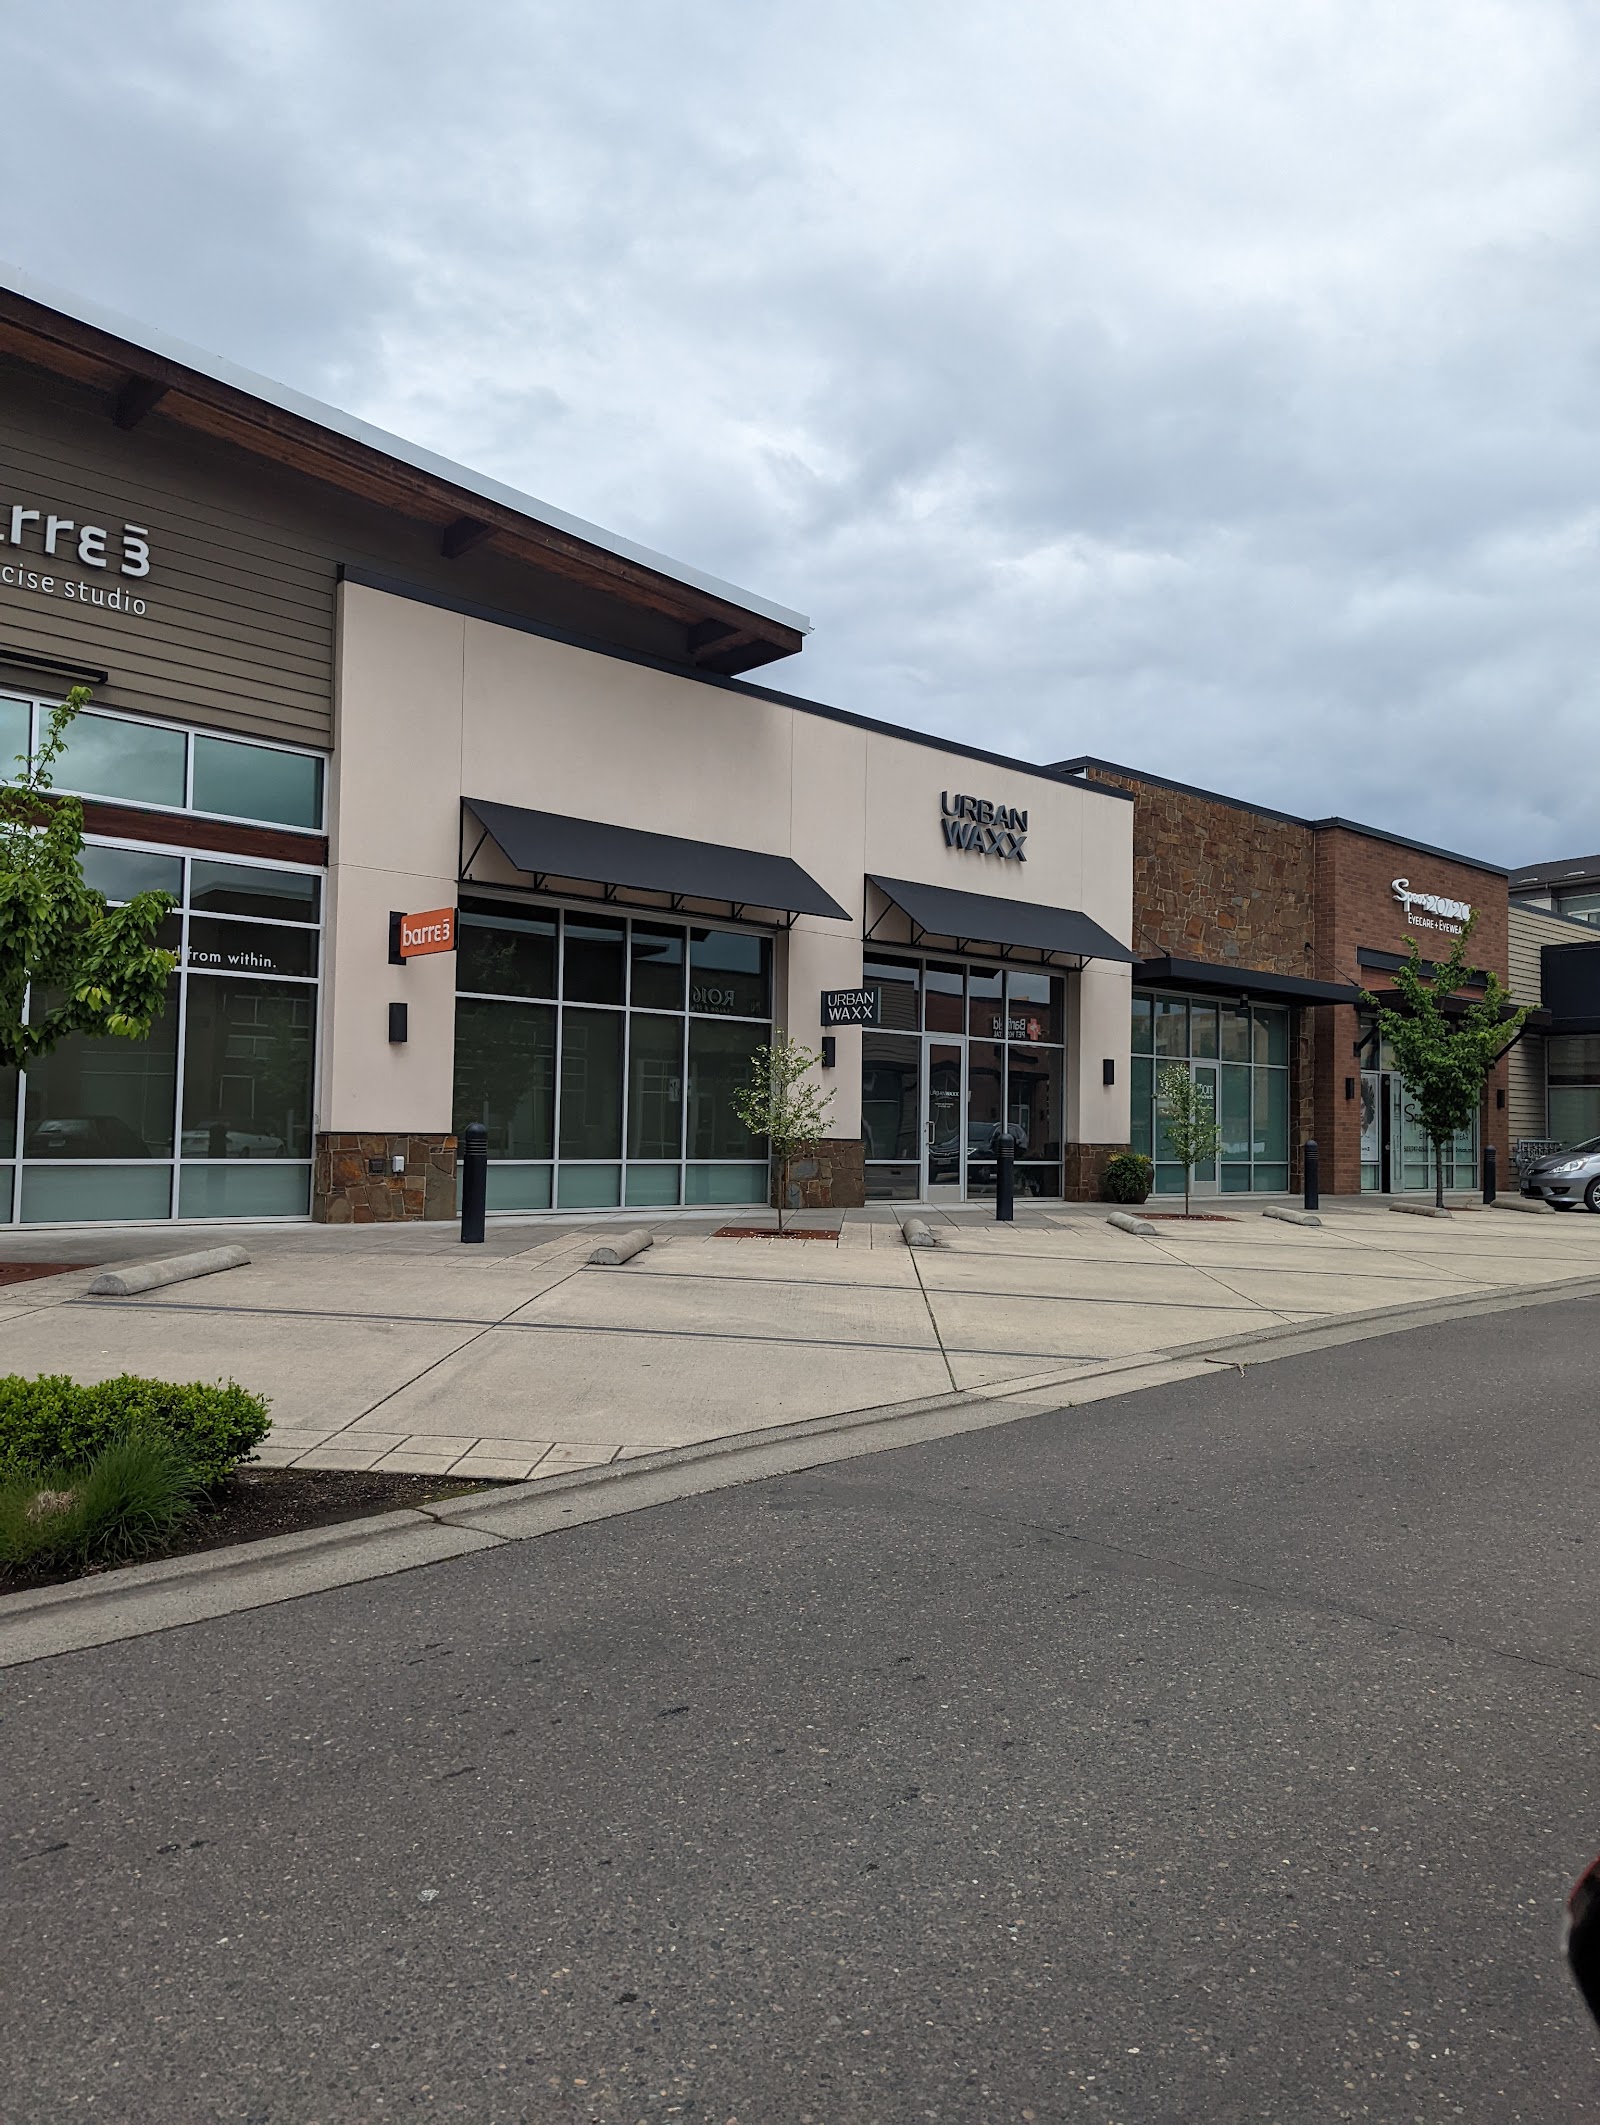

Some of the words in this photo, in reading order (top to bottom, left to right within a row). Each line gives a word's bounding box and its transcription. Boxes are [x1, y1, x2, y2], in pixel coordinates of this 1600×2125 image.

[0, 505, 150, 577] rre3
[64, 581, 146, 615] studio
[941, 791, 1028, 832] URBAN
[941, 818, 1028, 862] WAXX
[1439, 920, 1464, 935] EYEWEA
[228, 951, 277, 968] within.
[828, 991, 874, 1007] URBAN
[828, 1005, 873, 1021] WAXX
